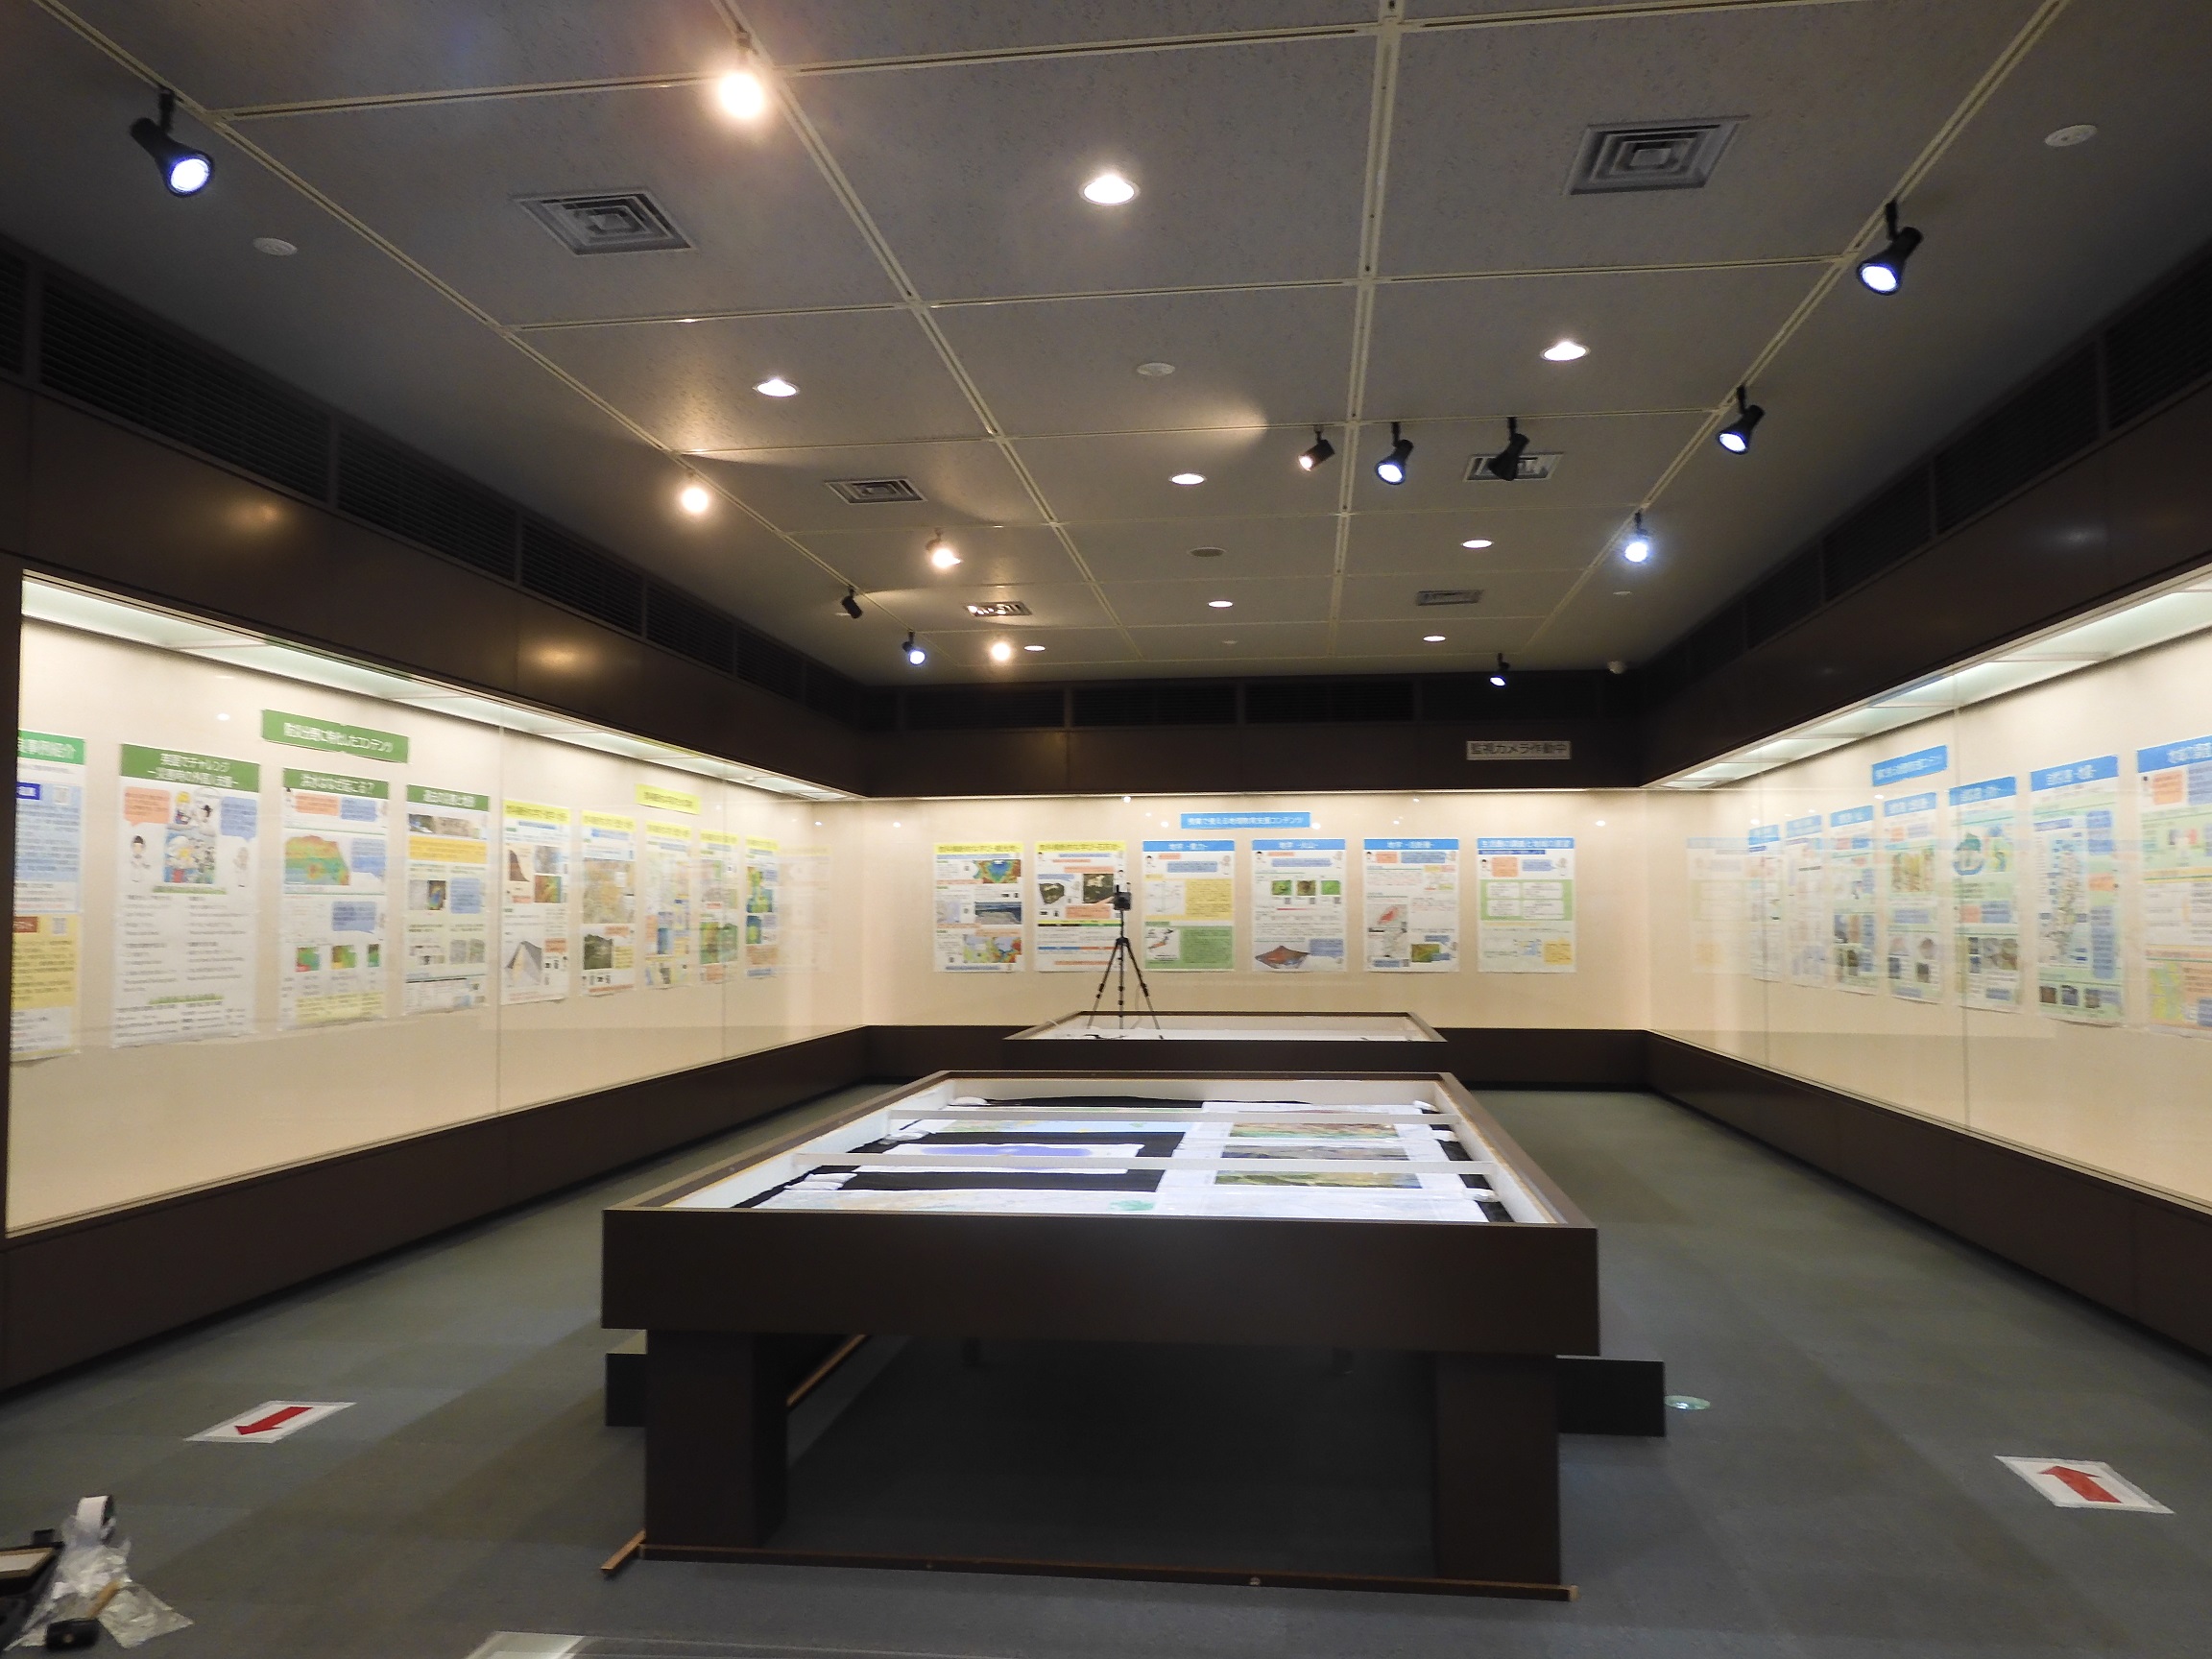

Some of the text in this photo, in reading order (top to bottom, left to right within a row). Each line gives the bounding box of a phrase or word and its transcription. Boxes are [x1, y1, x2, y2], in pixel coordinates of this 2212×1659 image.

[1470, 742, 1567, 755] 監視カメラ作動中
